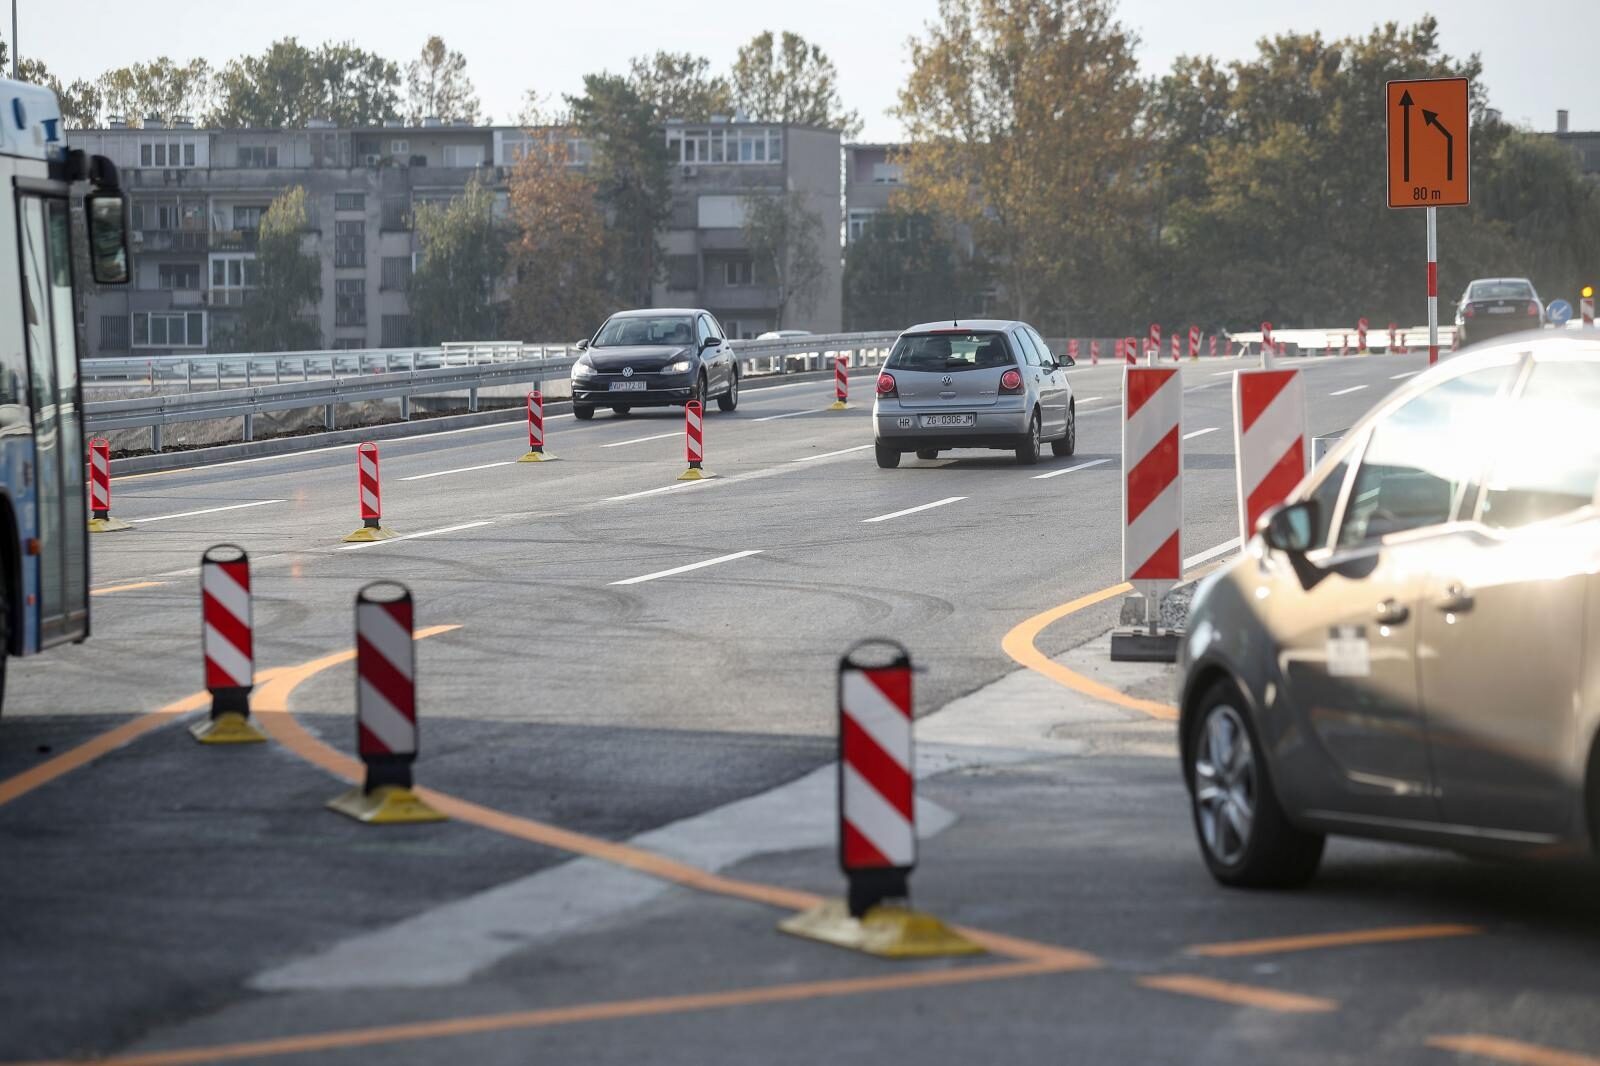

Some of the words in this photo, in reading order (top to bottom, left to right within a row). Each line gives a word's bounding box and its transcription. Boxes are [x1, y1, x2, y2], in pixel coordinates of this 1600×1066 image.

[1413, 186, 1427, 200] 80
[1431, 190, 1440, 200] m
[899, 418, 910, 427] HR
[927, 416, 937, 425] ZG
